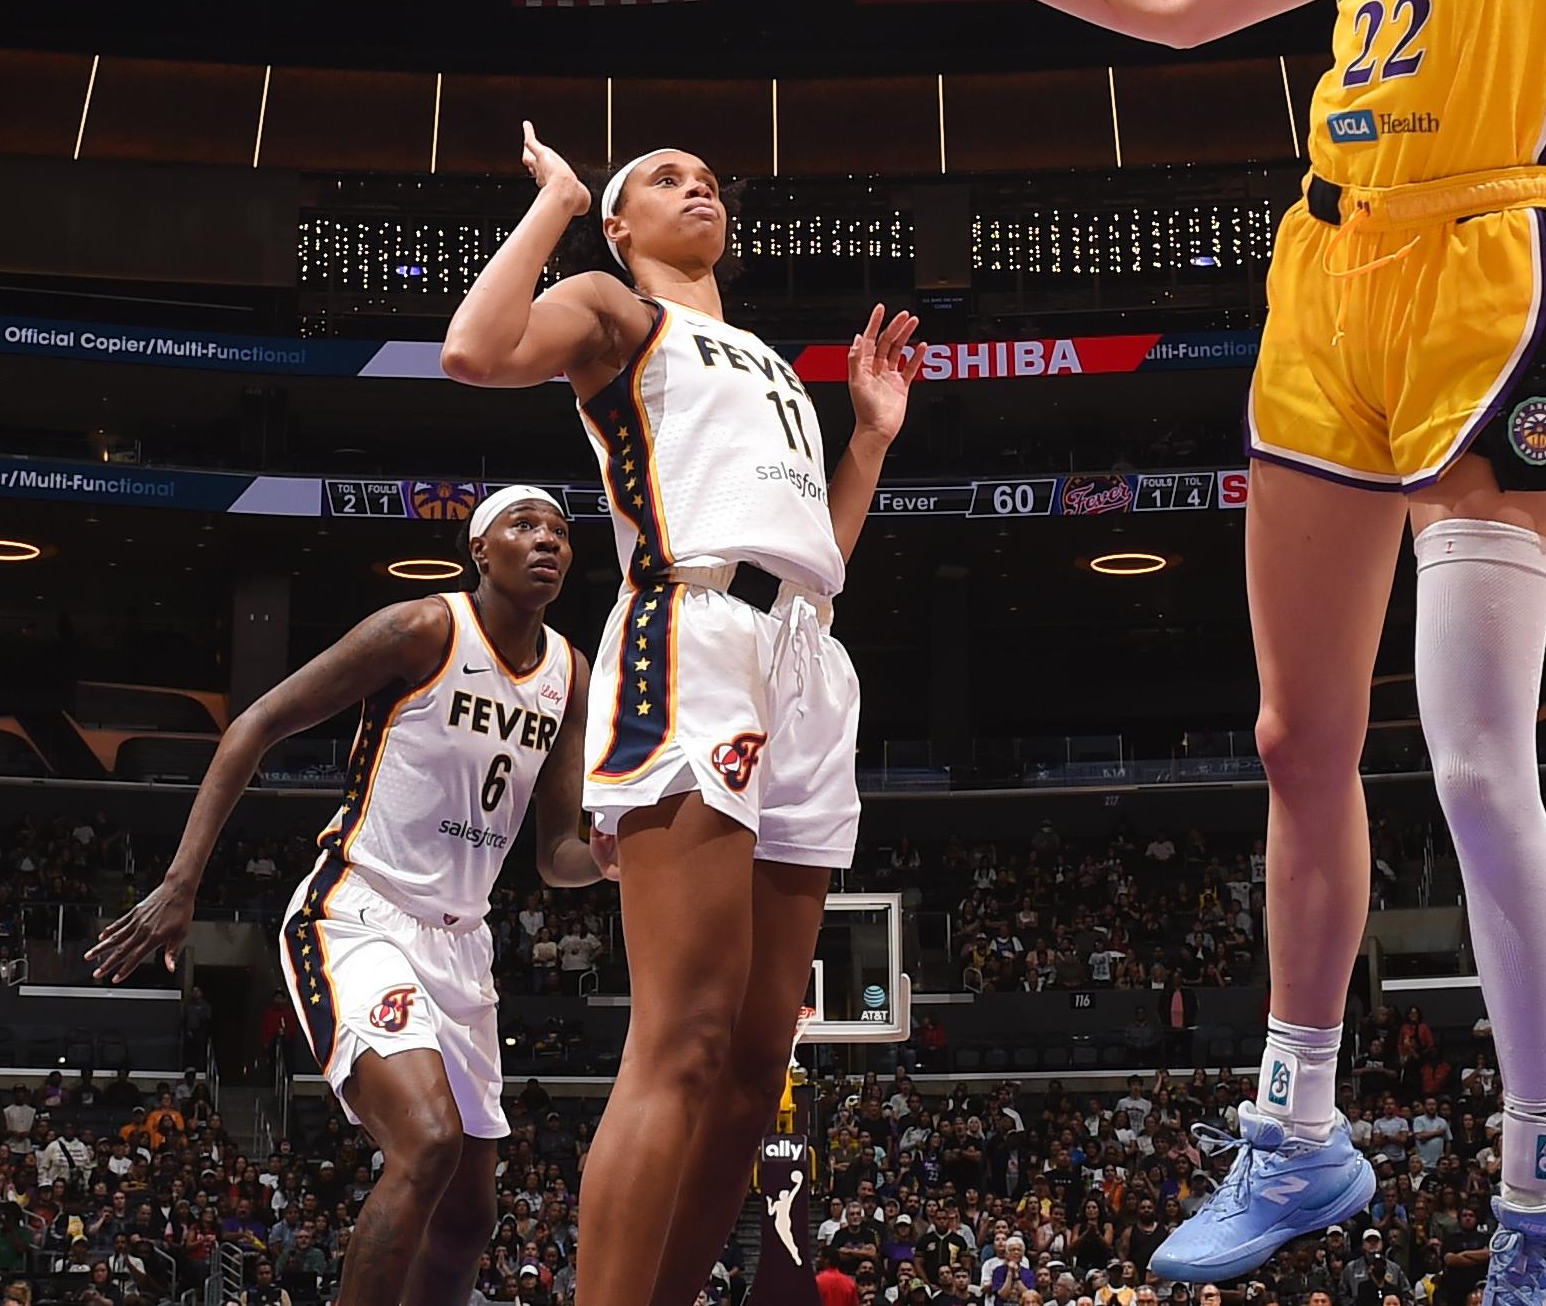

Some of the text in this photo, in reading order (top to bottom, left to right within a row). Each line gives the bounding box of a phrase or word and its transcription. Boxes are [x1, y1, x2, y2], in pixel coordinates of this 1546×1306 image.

[1332, 111, 1441, 137] UCLA Health
[3, 324, 307, 366] Official Copier/Multi-Functional
[899, 339, 1083, 381] SHIBA
[693, 334, 811, 402] FEVE
[766, 391, 813, 462] 11
[337, 482, 398, 495] TOL FOULS
[755, 462, 828, 506] salesfor
[1142, 476, 1203, 489] FOULS TOL
[343, 495, 390, 514] 2 1
[879, 493, 938, 511] Fever
[993, 484, 1035, 514] 60
[1065, 482, 1134, 516] Fever
[1152, 490, 1162, 508] 1
[1187, 488, 1202, 507] 4
[448, 689, 559, 752] FEVER
[483, 754, 512, 812] 6
[438, 818, 509, 851] salesforce
[860, 1009, 890, 1022] AT&T
[1074, 993, 1091, 1008] 116
[765, 1139, 803, 1162] ally
